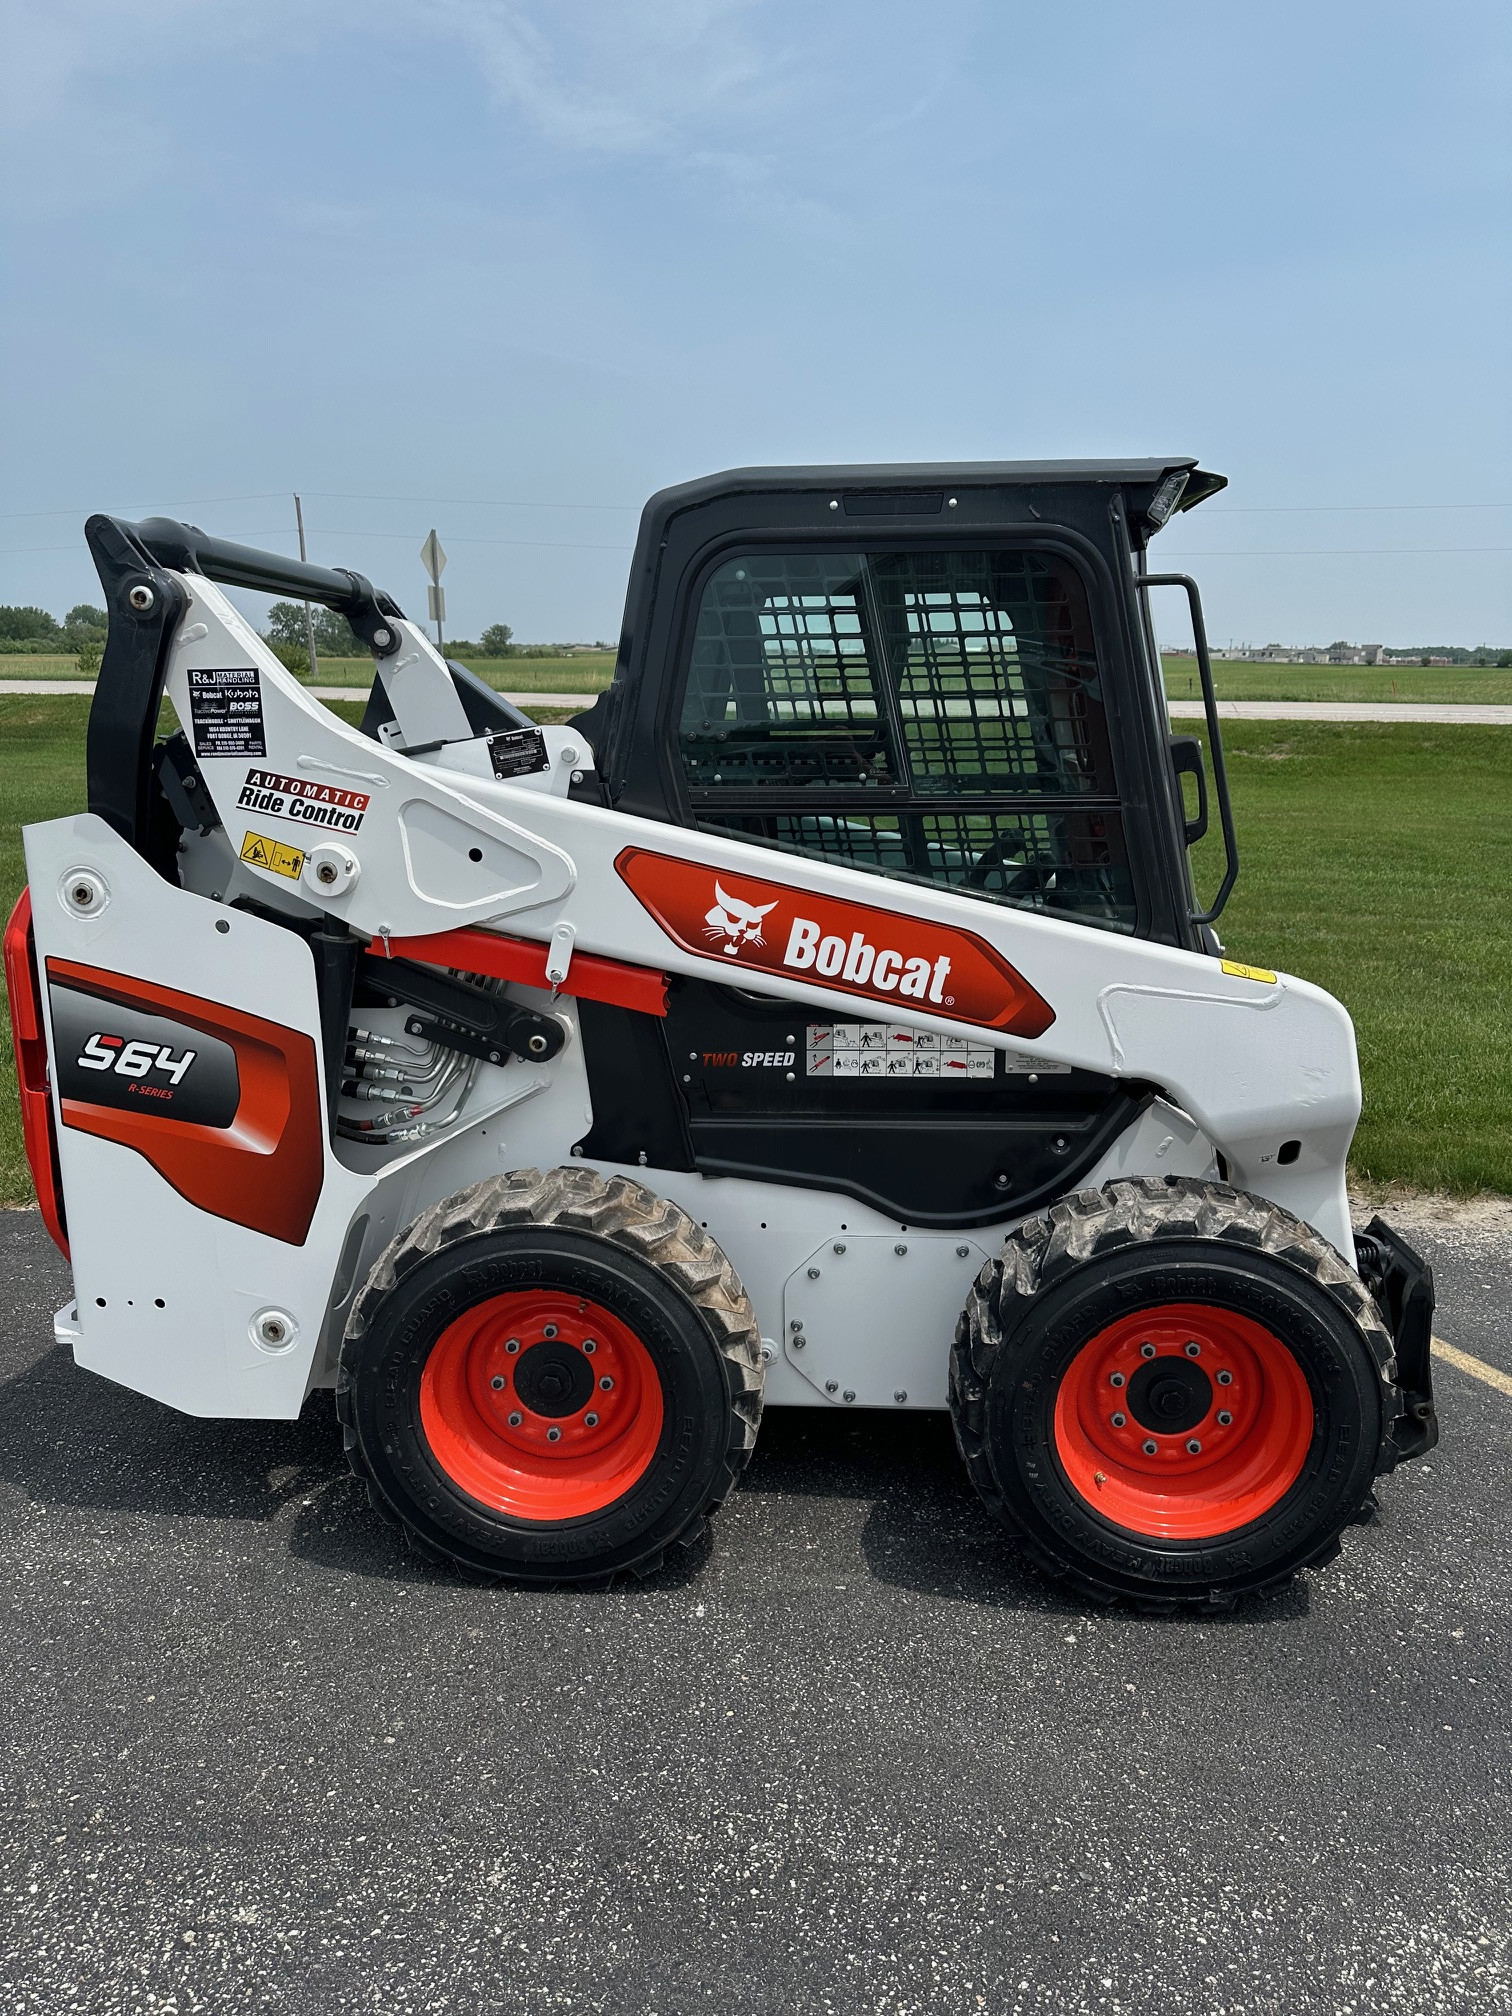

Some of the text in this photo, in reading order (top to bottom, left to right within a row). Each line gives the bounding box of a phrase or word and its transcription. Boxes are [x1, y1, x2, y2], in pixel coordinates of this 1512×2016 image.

[192, 672, 216, 684] R&J
[225, 689, 259, 698] Kubota
[230, 702, 259, 710] BOSS
[250, 772, 365, 809] AUTOMATIC
[237, 786, 365, 832] Ride Control
[783, 916, 951, 1004] Bobcat
[77, 1033, 196, 1085] S64
[702, 1052, 796, 1067] TWO SPEED
[128, 1083, 174, 1100] R-SERIES
